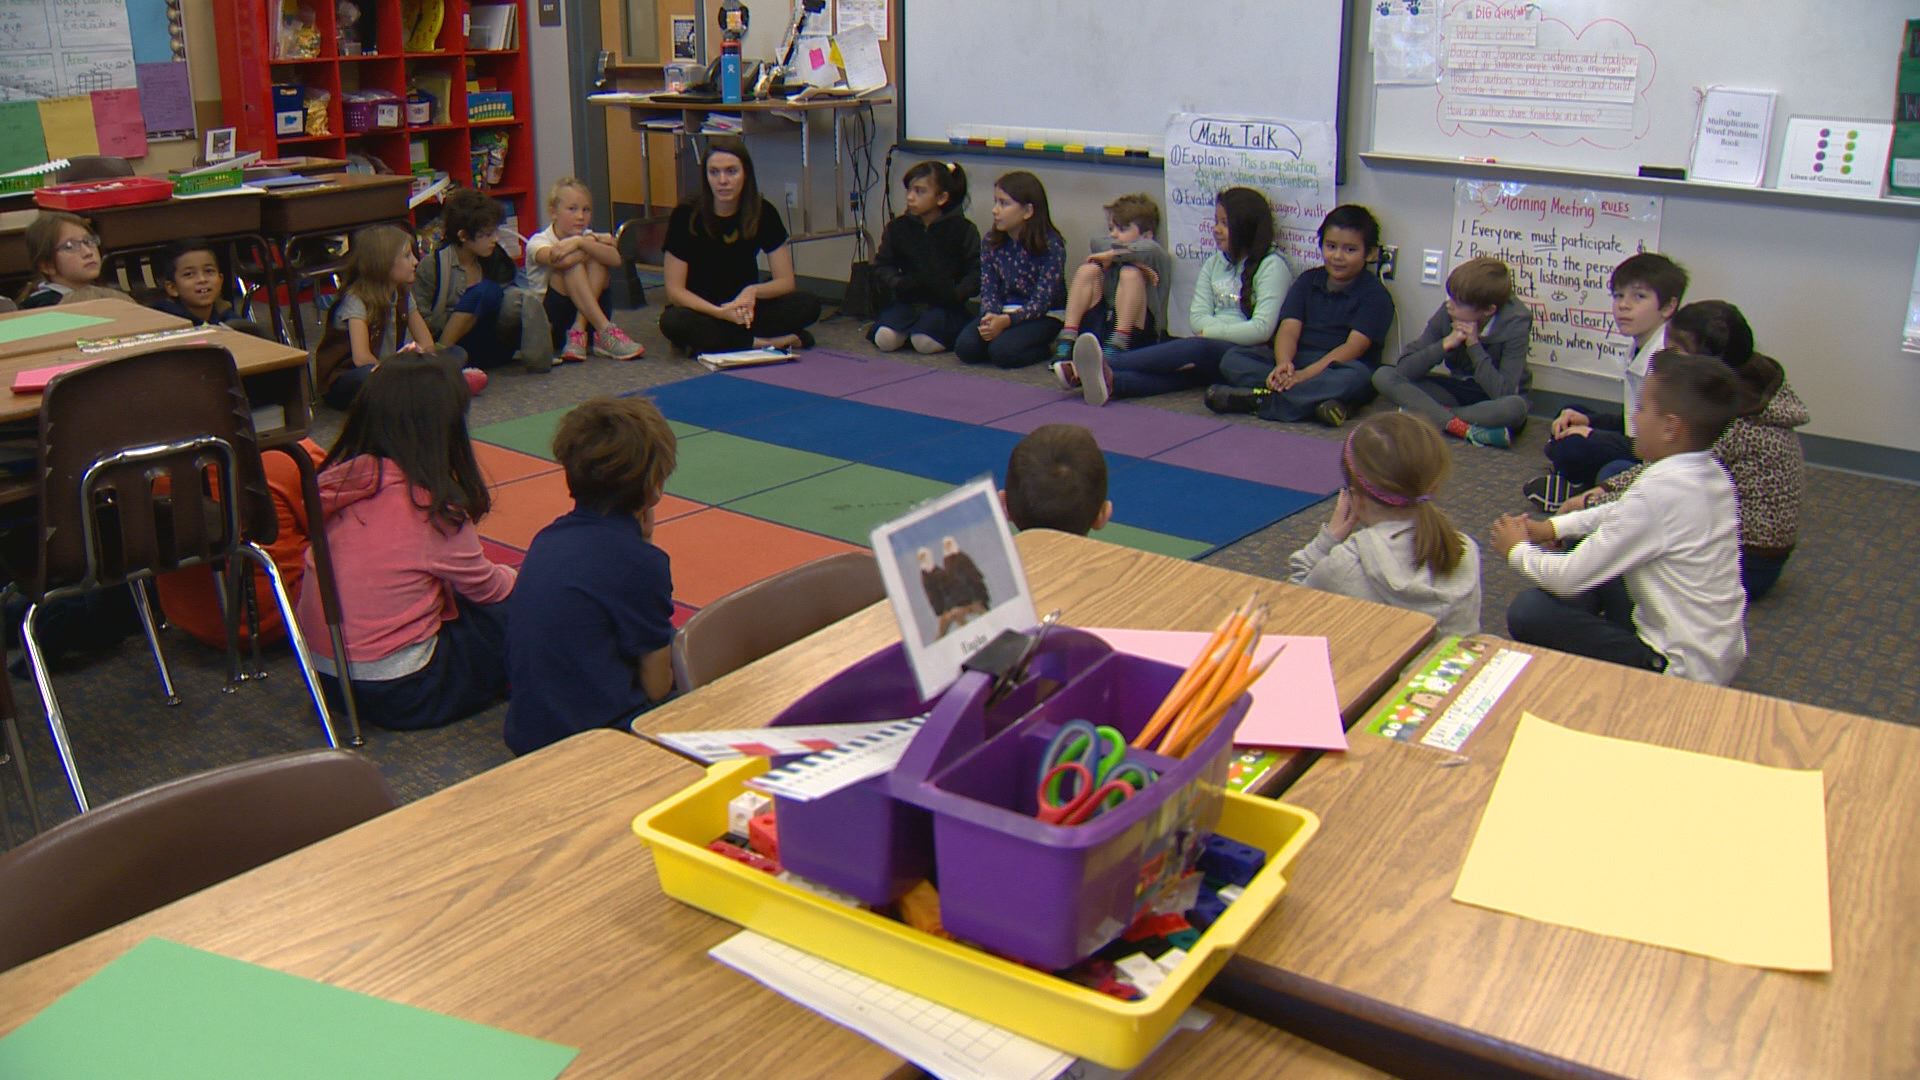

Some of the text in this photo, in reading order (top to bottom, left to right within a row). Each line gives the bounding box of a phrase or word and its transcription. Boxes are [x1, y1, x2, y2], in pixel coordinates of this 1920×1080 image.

[1456, 24, 1479, 39] What
[1199, 122, 1233, 147] Math
[1706, 127, 1758, 140] Word Problem
[1708, 117, 1759, 129] Multiplication
[1721, 138, 1739, 147] Book
[1790, 173, 1808, 181] Lines
[1818, 175, 1872, 186] Communication
[1304, 203, 1327, 218] with
[1494, 193, 1629, 229] Morning Meeting RULES
[1471, 220, 1523, 244] Everyone
[1531, 228, 1557, 245] must
[1493, 244, 1543, 267] attention
[1547, 253, 1558, 269] to
[1563, 256, 1582, 271] the
[1586, 259, 1615, 279] perso
[1540, 268, 1581, 292] listening
[1583, 276, 1602, 289] and
[1550, 307, 1568, 324] and
[1573, 309, 1613, 339] clearly
[1532, 326, 1562, 346] thumb
[1566, 332, 1593, 350] when
